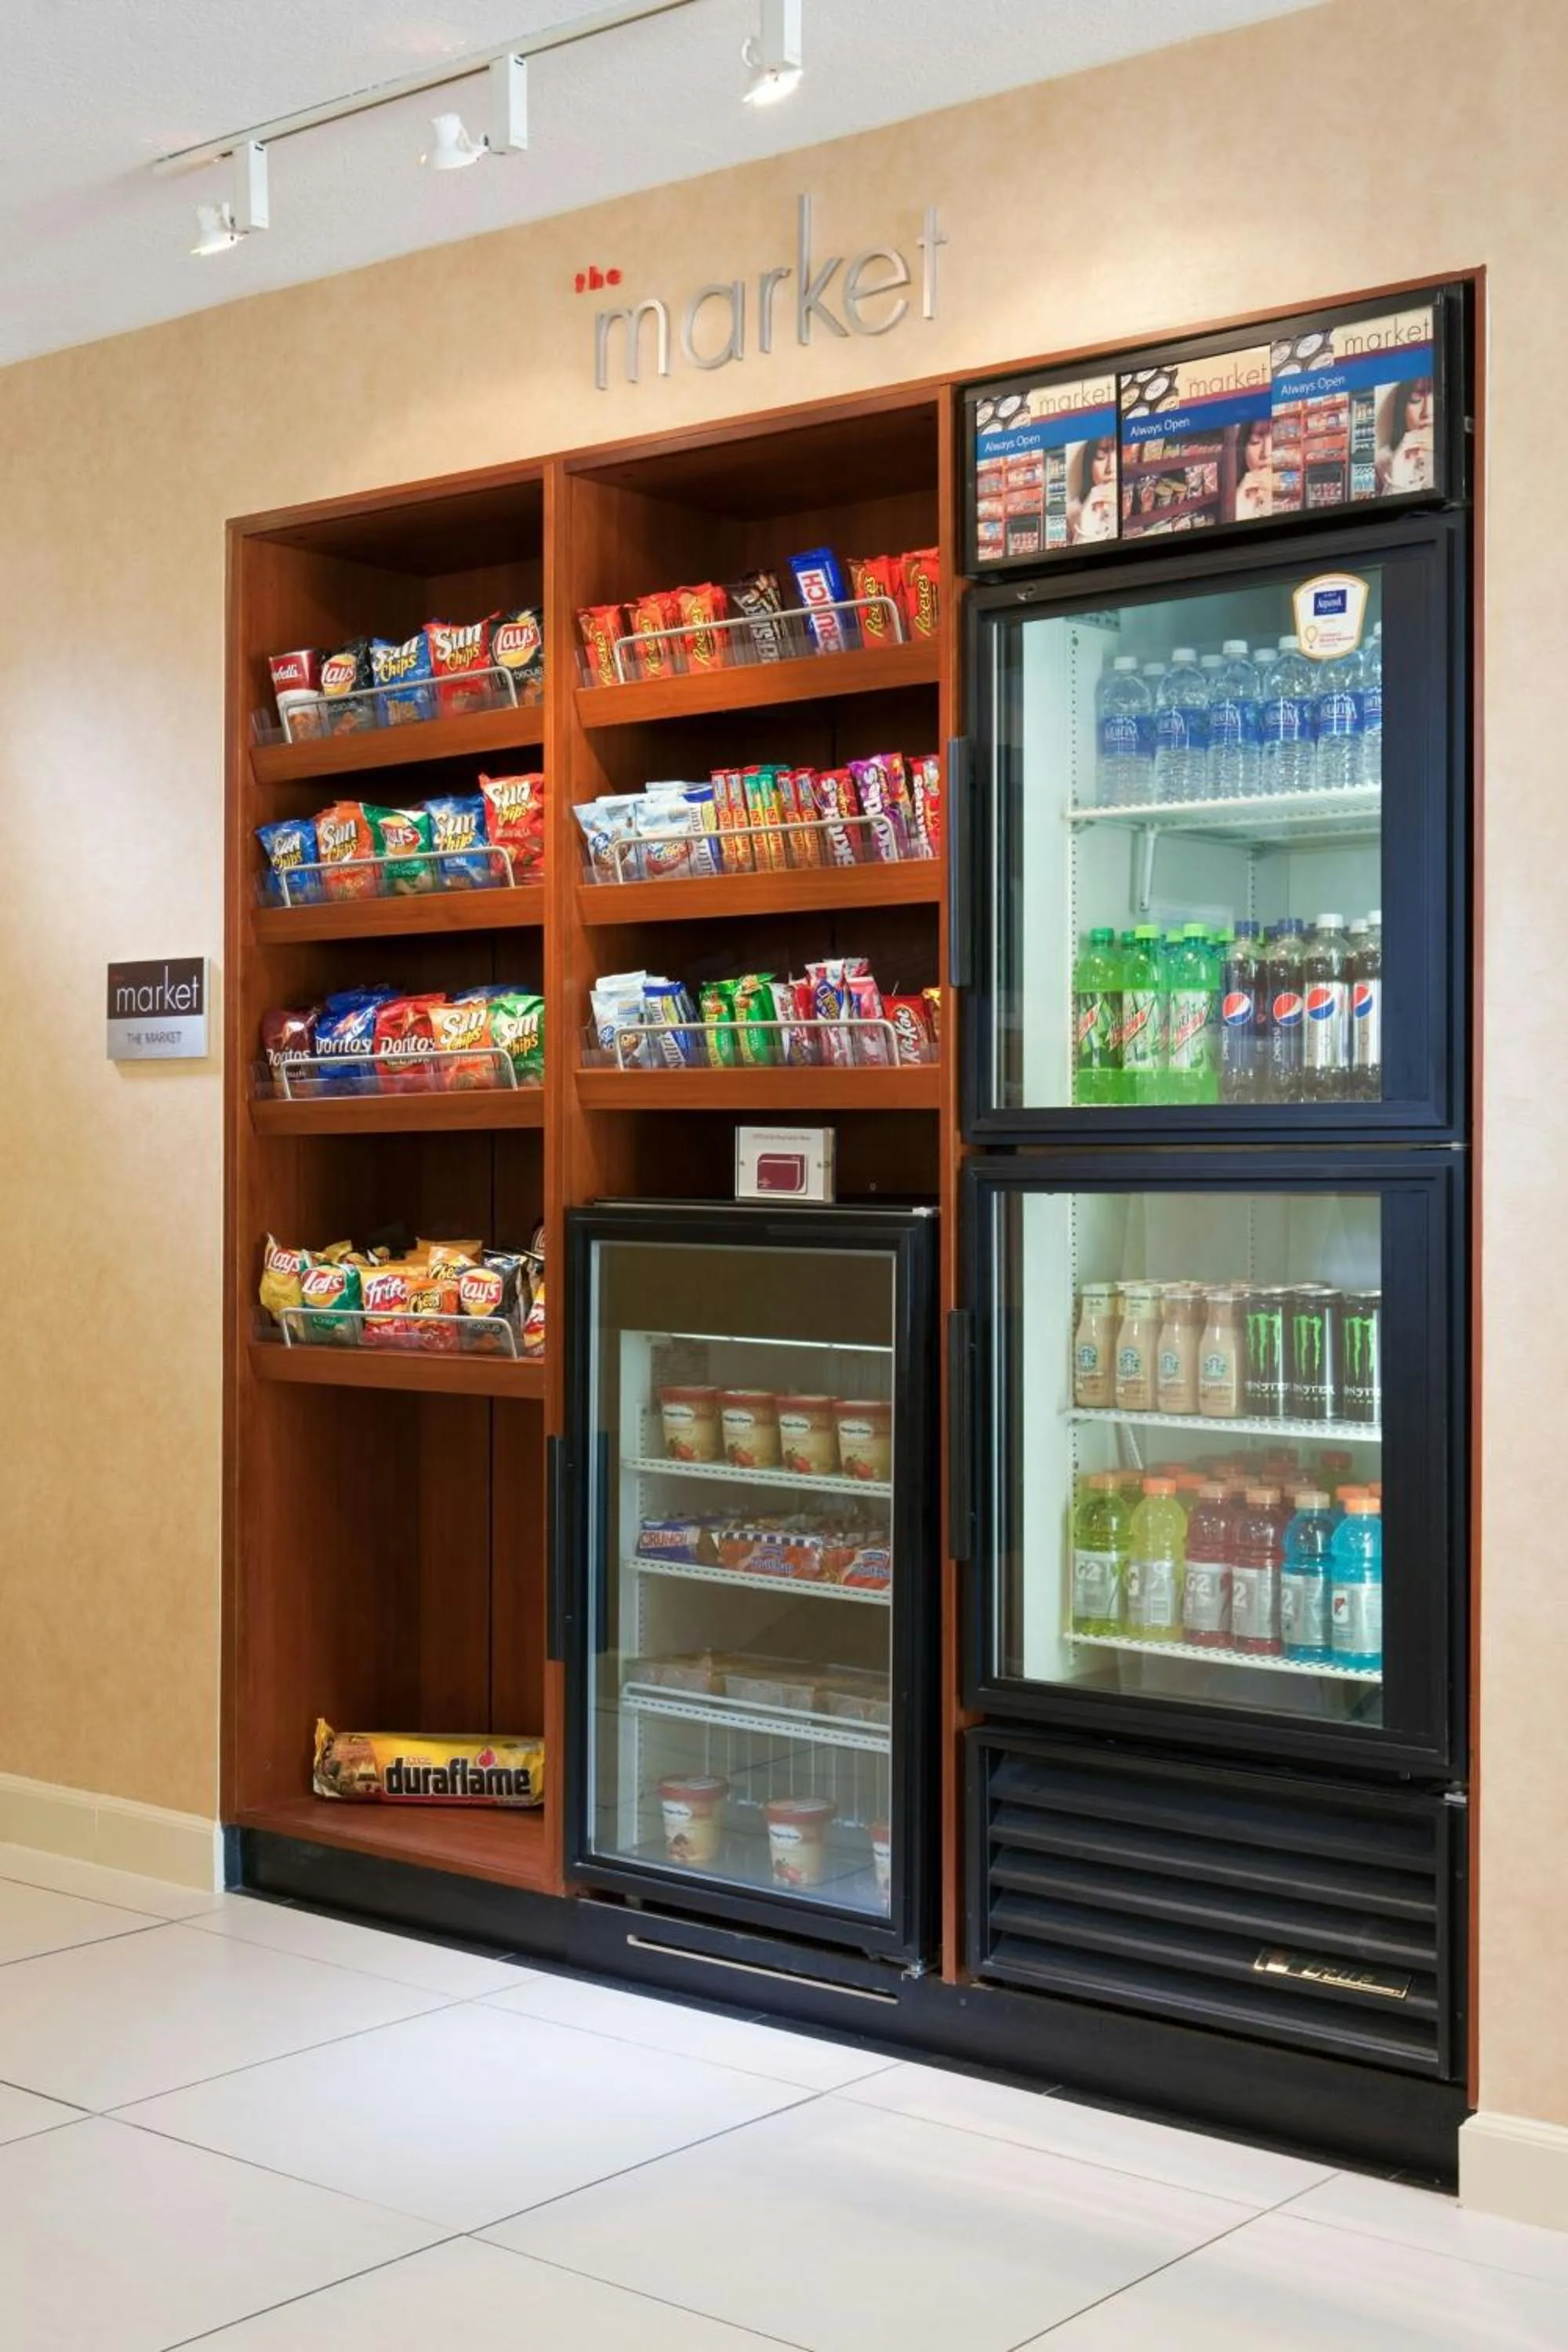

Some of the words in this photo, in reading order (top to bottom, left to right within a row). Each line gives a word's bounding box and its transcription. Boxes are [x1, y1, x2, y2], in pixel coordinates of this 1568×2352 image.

[575, 267, 622, 294] the
[595, 193, 949, 390] market
[1344, 317, 1431, 355] market
[1189, 362, 1268, 397] market
[1281, 380, 1316, 396] Always
[1317, 375, 1345, 390] Open
[1039, 379, 1112, 415] market
[1130, 423, 1163, 437] Always
[1164, 416, 1190, 432] Open
[984, 440, 1015, 453] Always
[1018, 434, 1041, 449] Open
[372, 636, 420, 672] Sun
[436, 624, 483, 660] Sun
[447, 643, 481, 671] Chips
[380, 654, 417, 682] Chips
[488, 782, 531, 808] Sun
[320, 820, 357, 854] Sun
[434, 813, 477, 844] Sun
[116, 965, 201, 1012] market
[126, 1032, 143, 1045] THE
[145, 1030, 183, 1044] MARKET
[386, 1757, 531, 1795] duraflame
